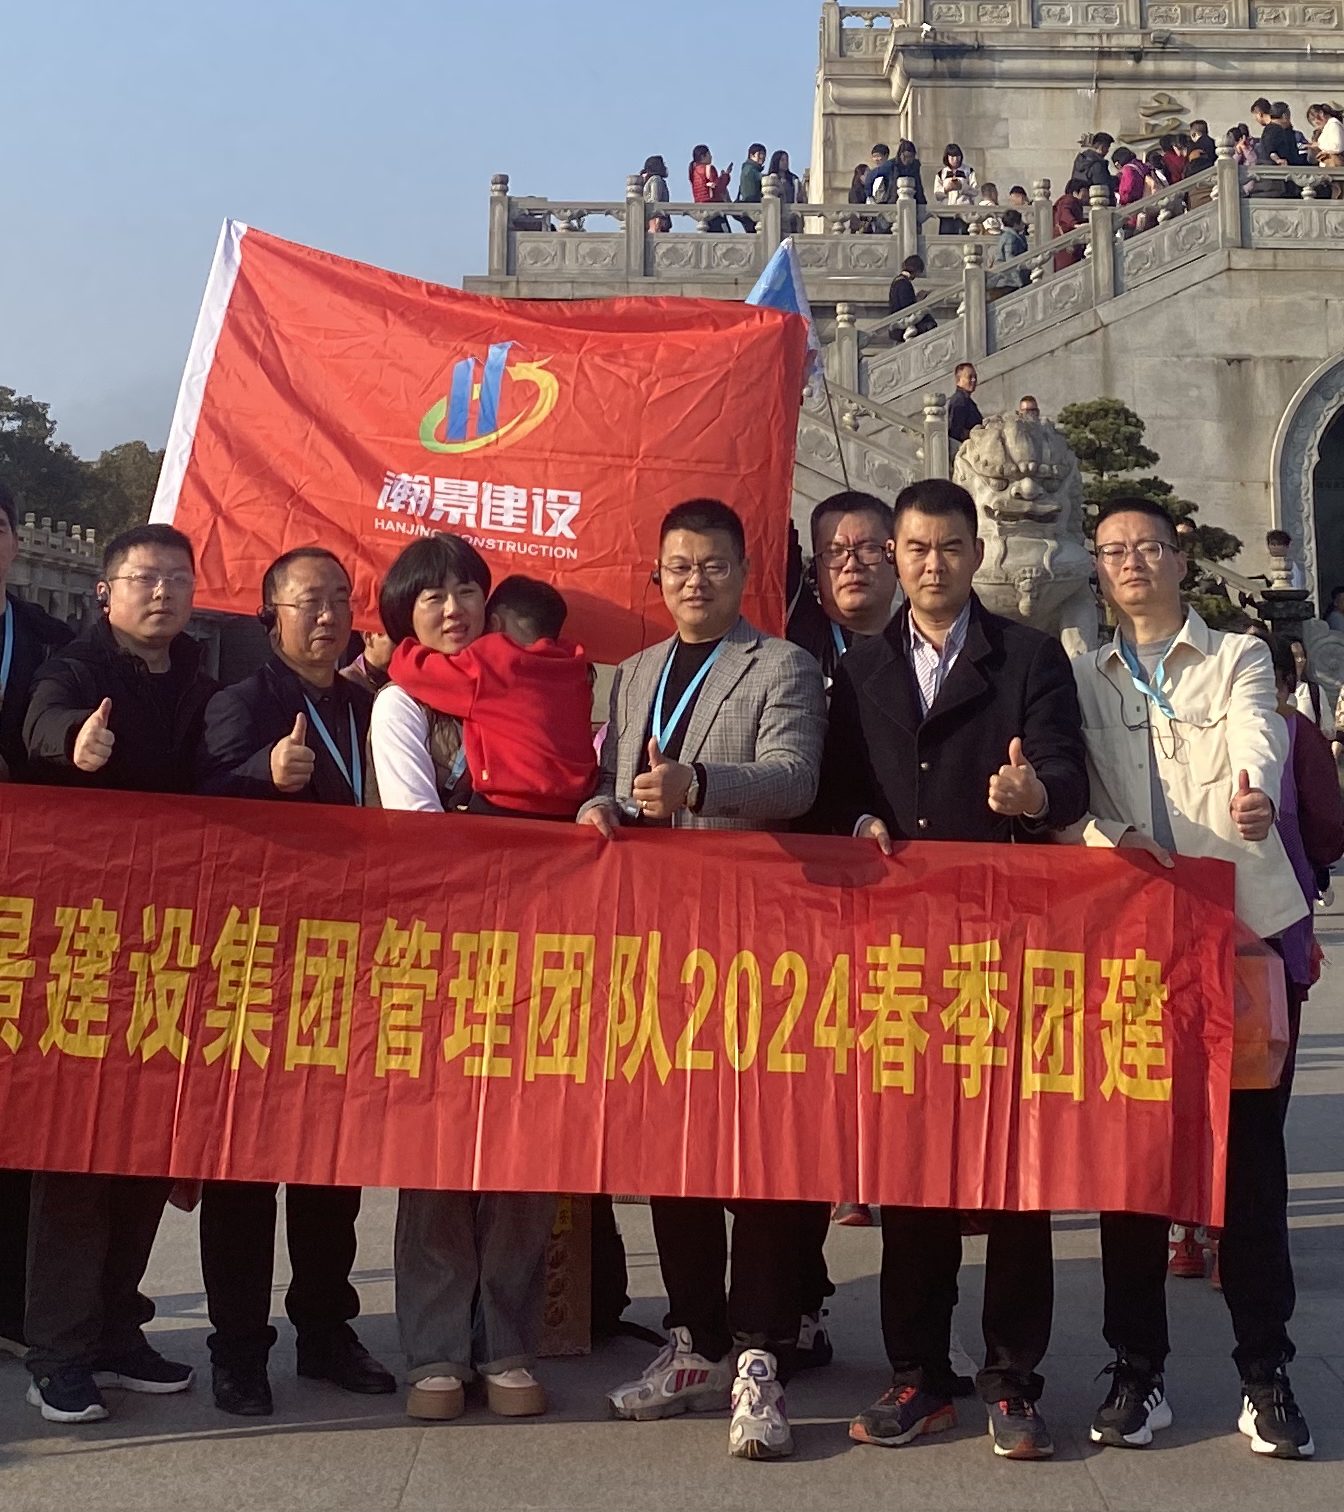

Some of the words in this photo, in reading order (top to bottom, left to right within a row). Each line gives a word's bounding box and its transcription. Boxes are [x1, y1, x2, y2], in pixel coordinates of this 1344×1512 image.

[376, 470, 582, 540] 瀚景建设
[455, 533, 578, 560] ONSTRUCTION
